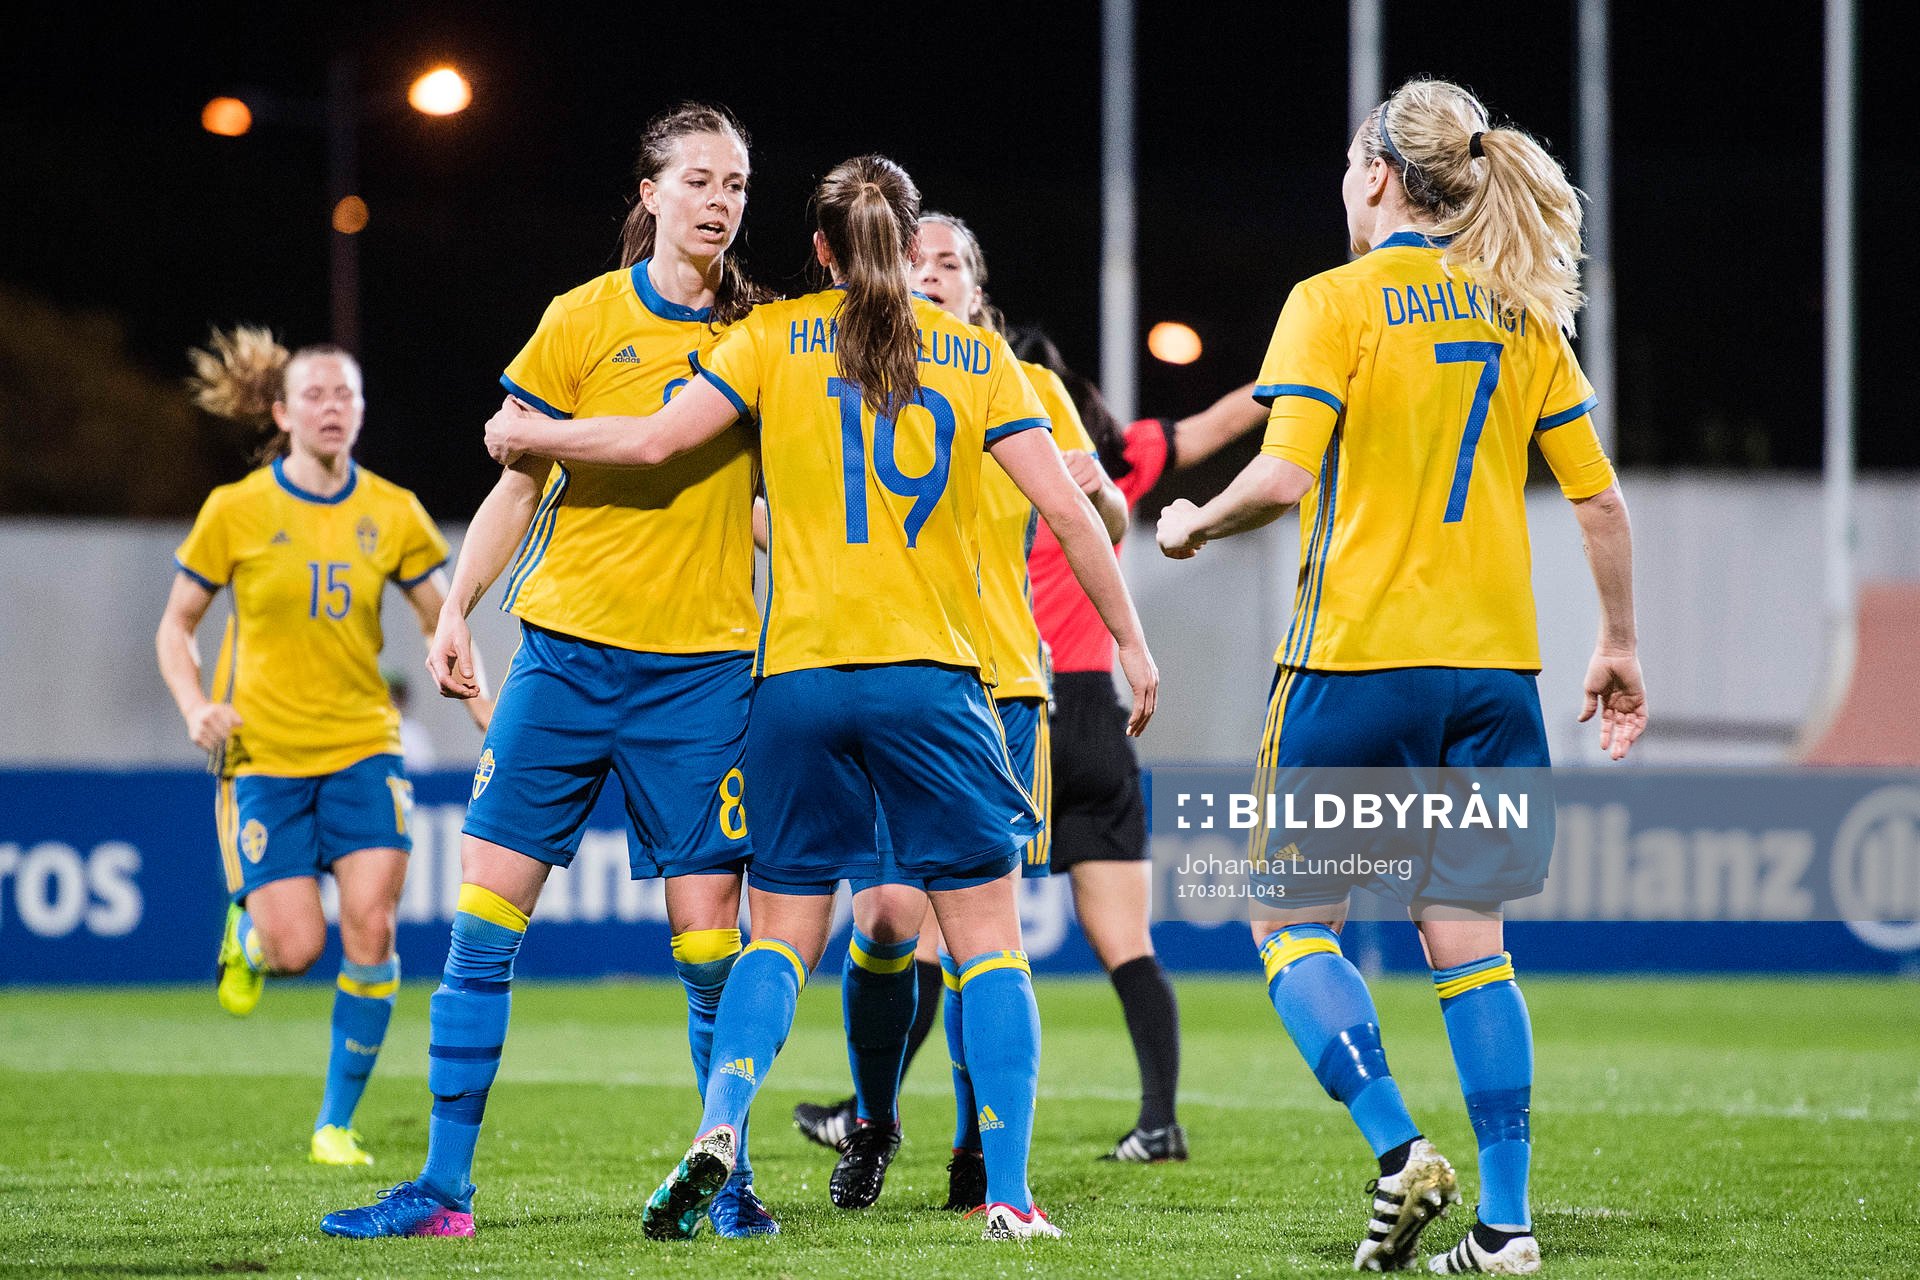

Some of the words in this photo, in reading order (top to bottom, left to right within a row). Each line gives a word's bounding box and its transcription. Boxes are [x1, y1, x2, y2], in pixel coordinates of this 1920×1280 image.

[612, 353, 640, 364] adidas
[790, 317, 991, 375] HALUND
[1434, 341, 1504, 523] 7
[827, 377, 957, 548] 19
[308, 563, 352, 620] 15
[719, 768, 748, 840] 8
[720, 1066, 756, 1085] adidas
